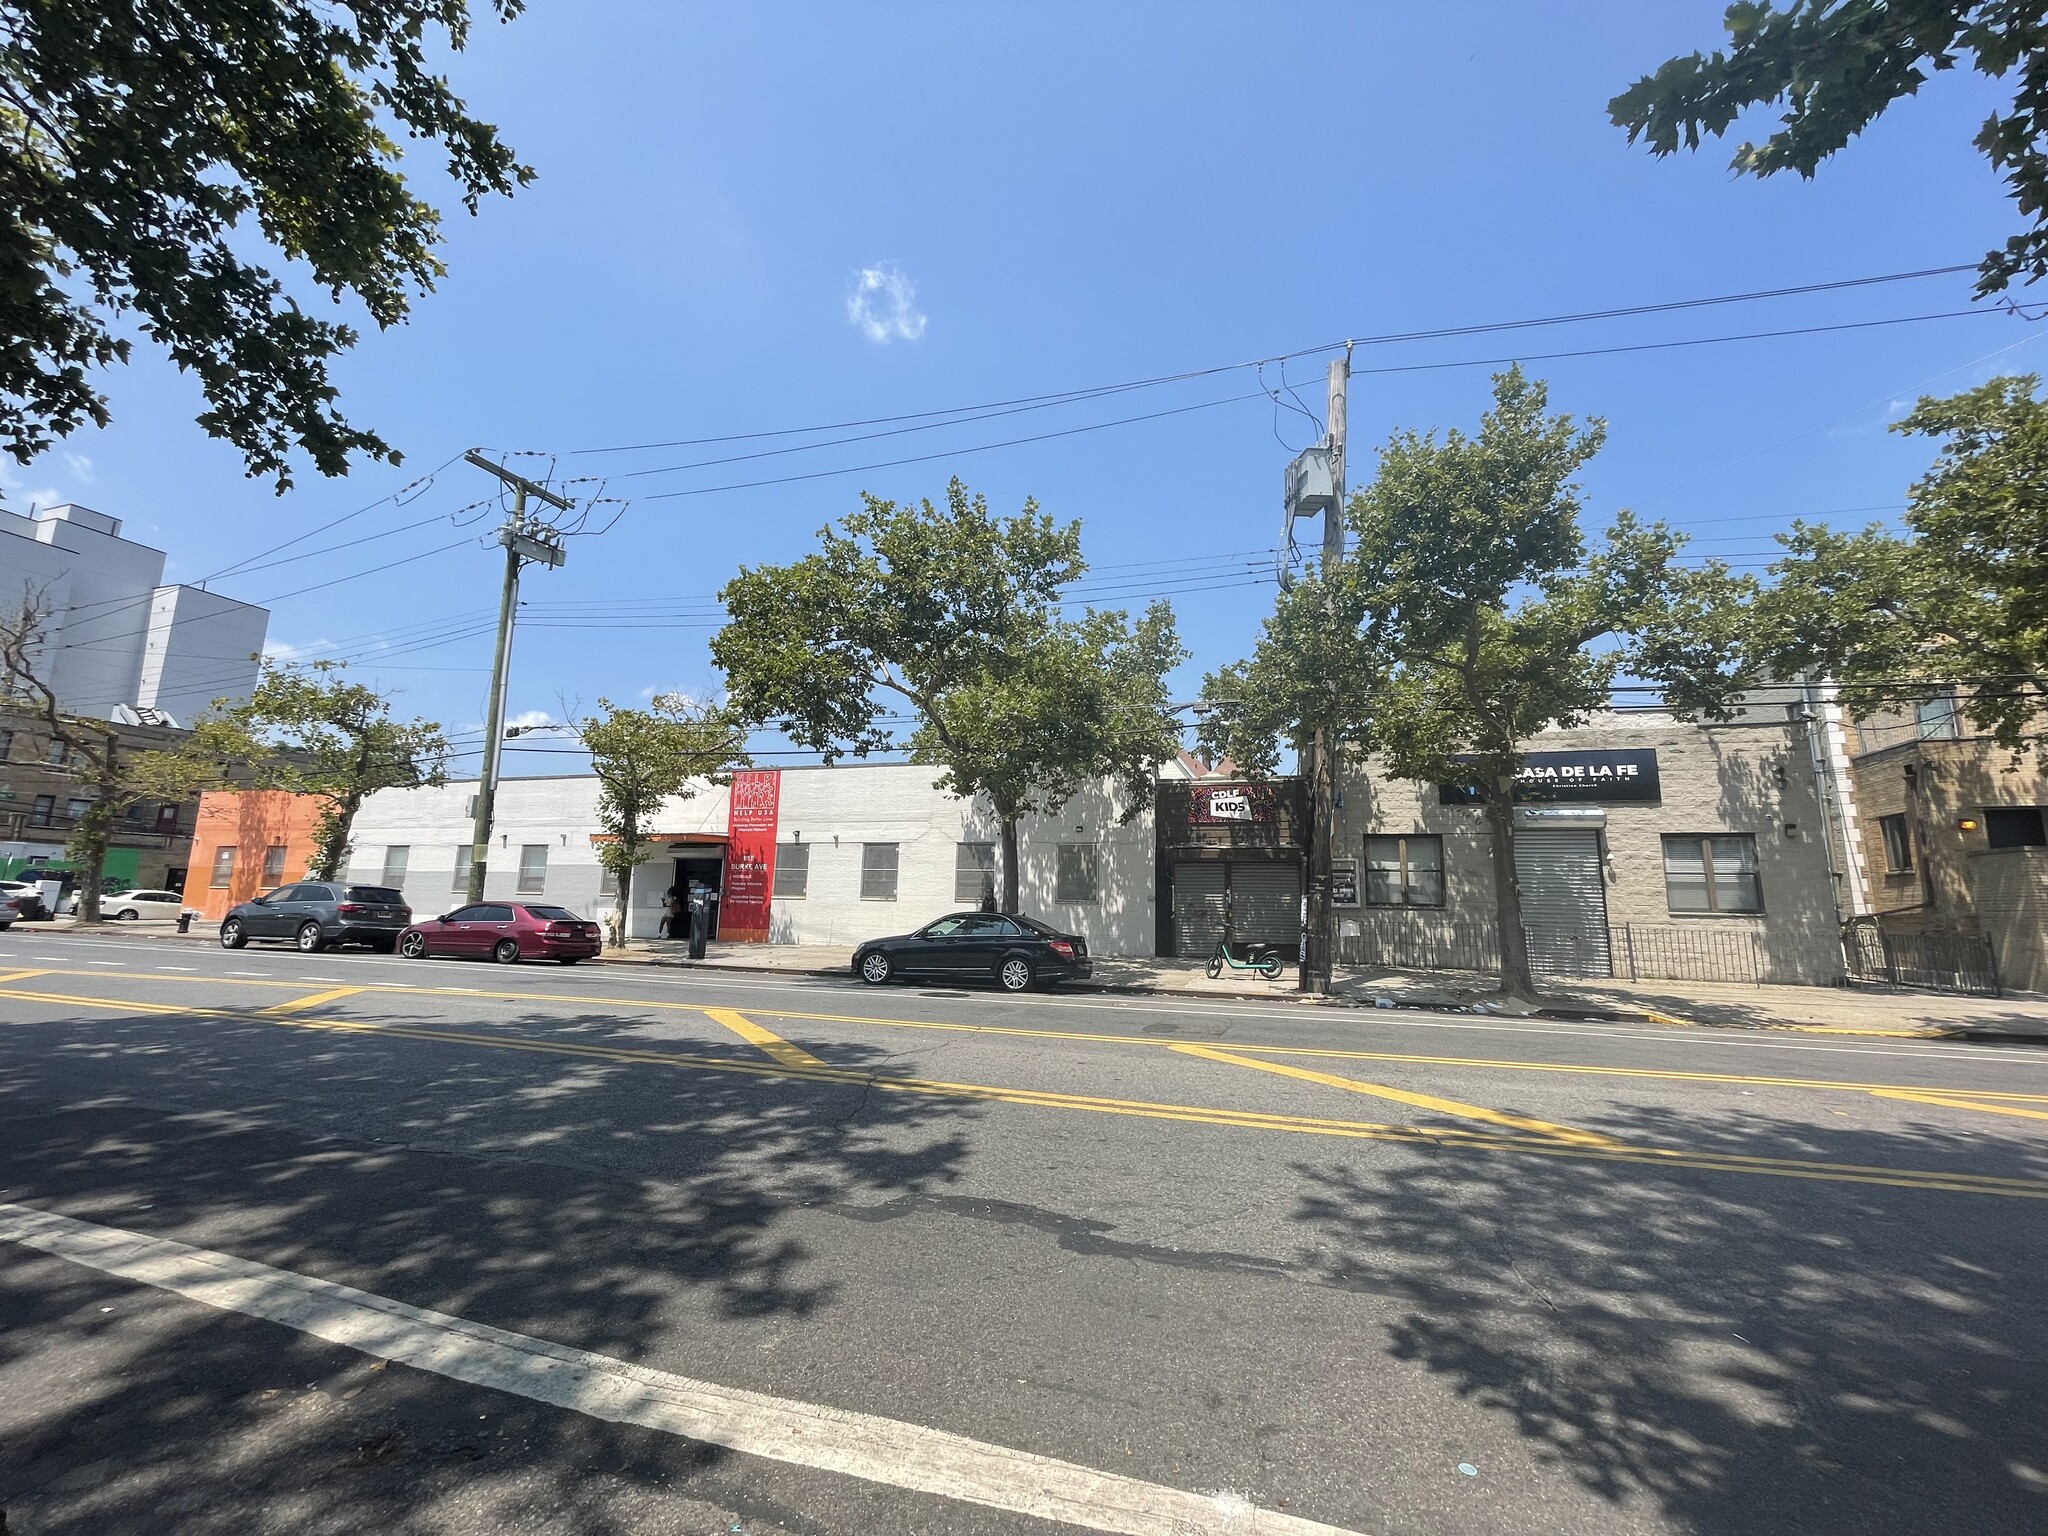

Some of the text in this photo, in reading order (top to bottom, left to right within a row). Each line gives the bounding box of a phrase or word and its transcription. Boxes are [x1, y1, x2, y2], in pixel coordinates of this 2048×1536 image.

[1561, 766, 1585, 777] DE
[1589, 765, 1613, 776] LA
[1616, 764, 1639, 776] FE
[1211, 789, 1240, 799] CDLF
[1215, 802, 1246, 812] KIDS
